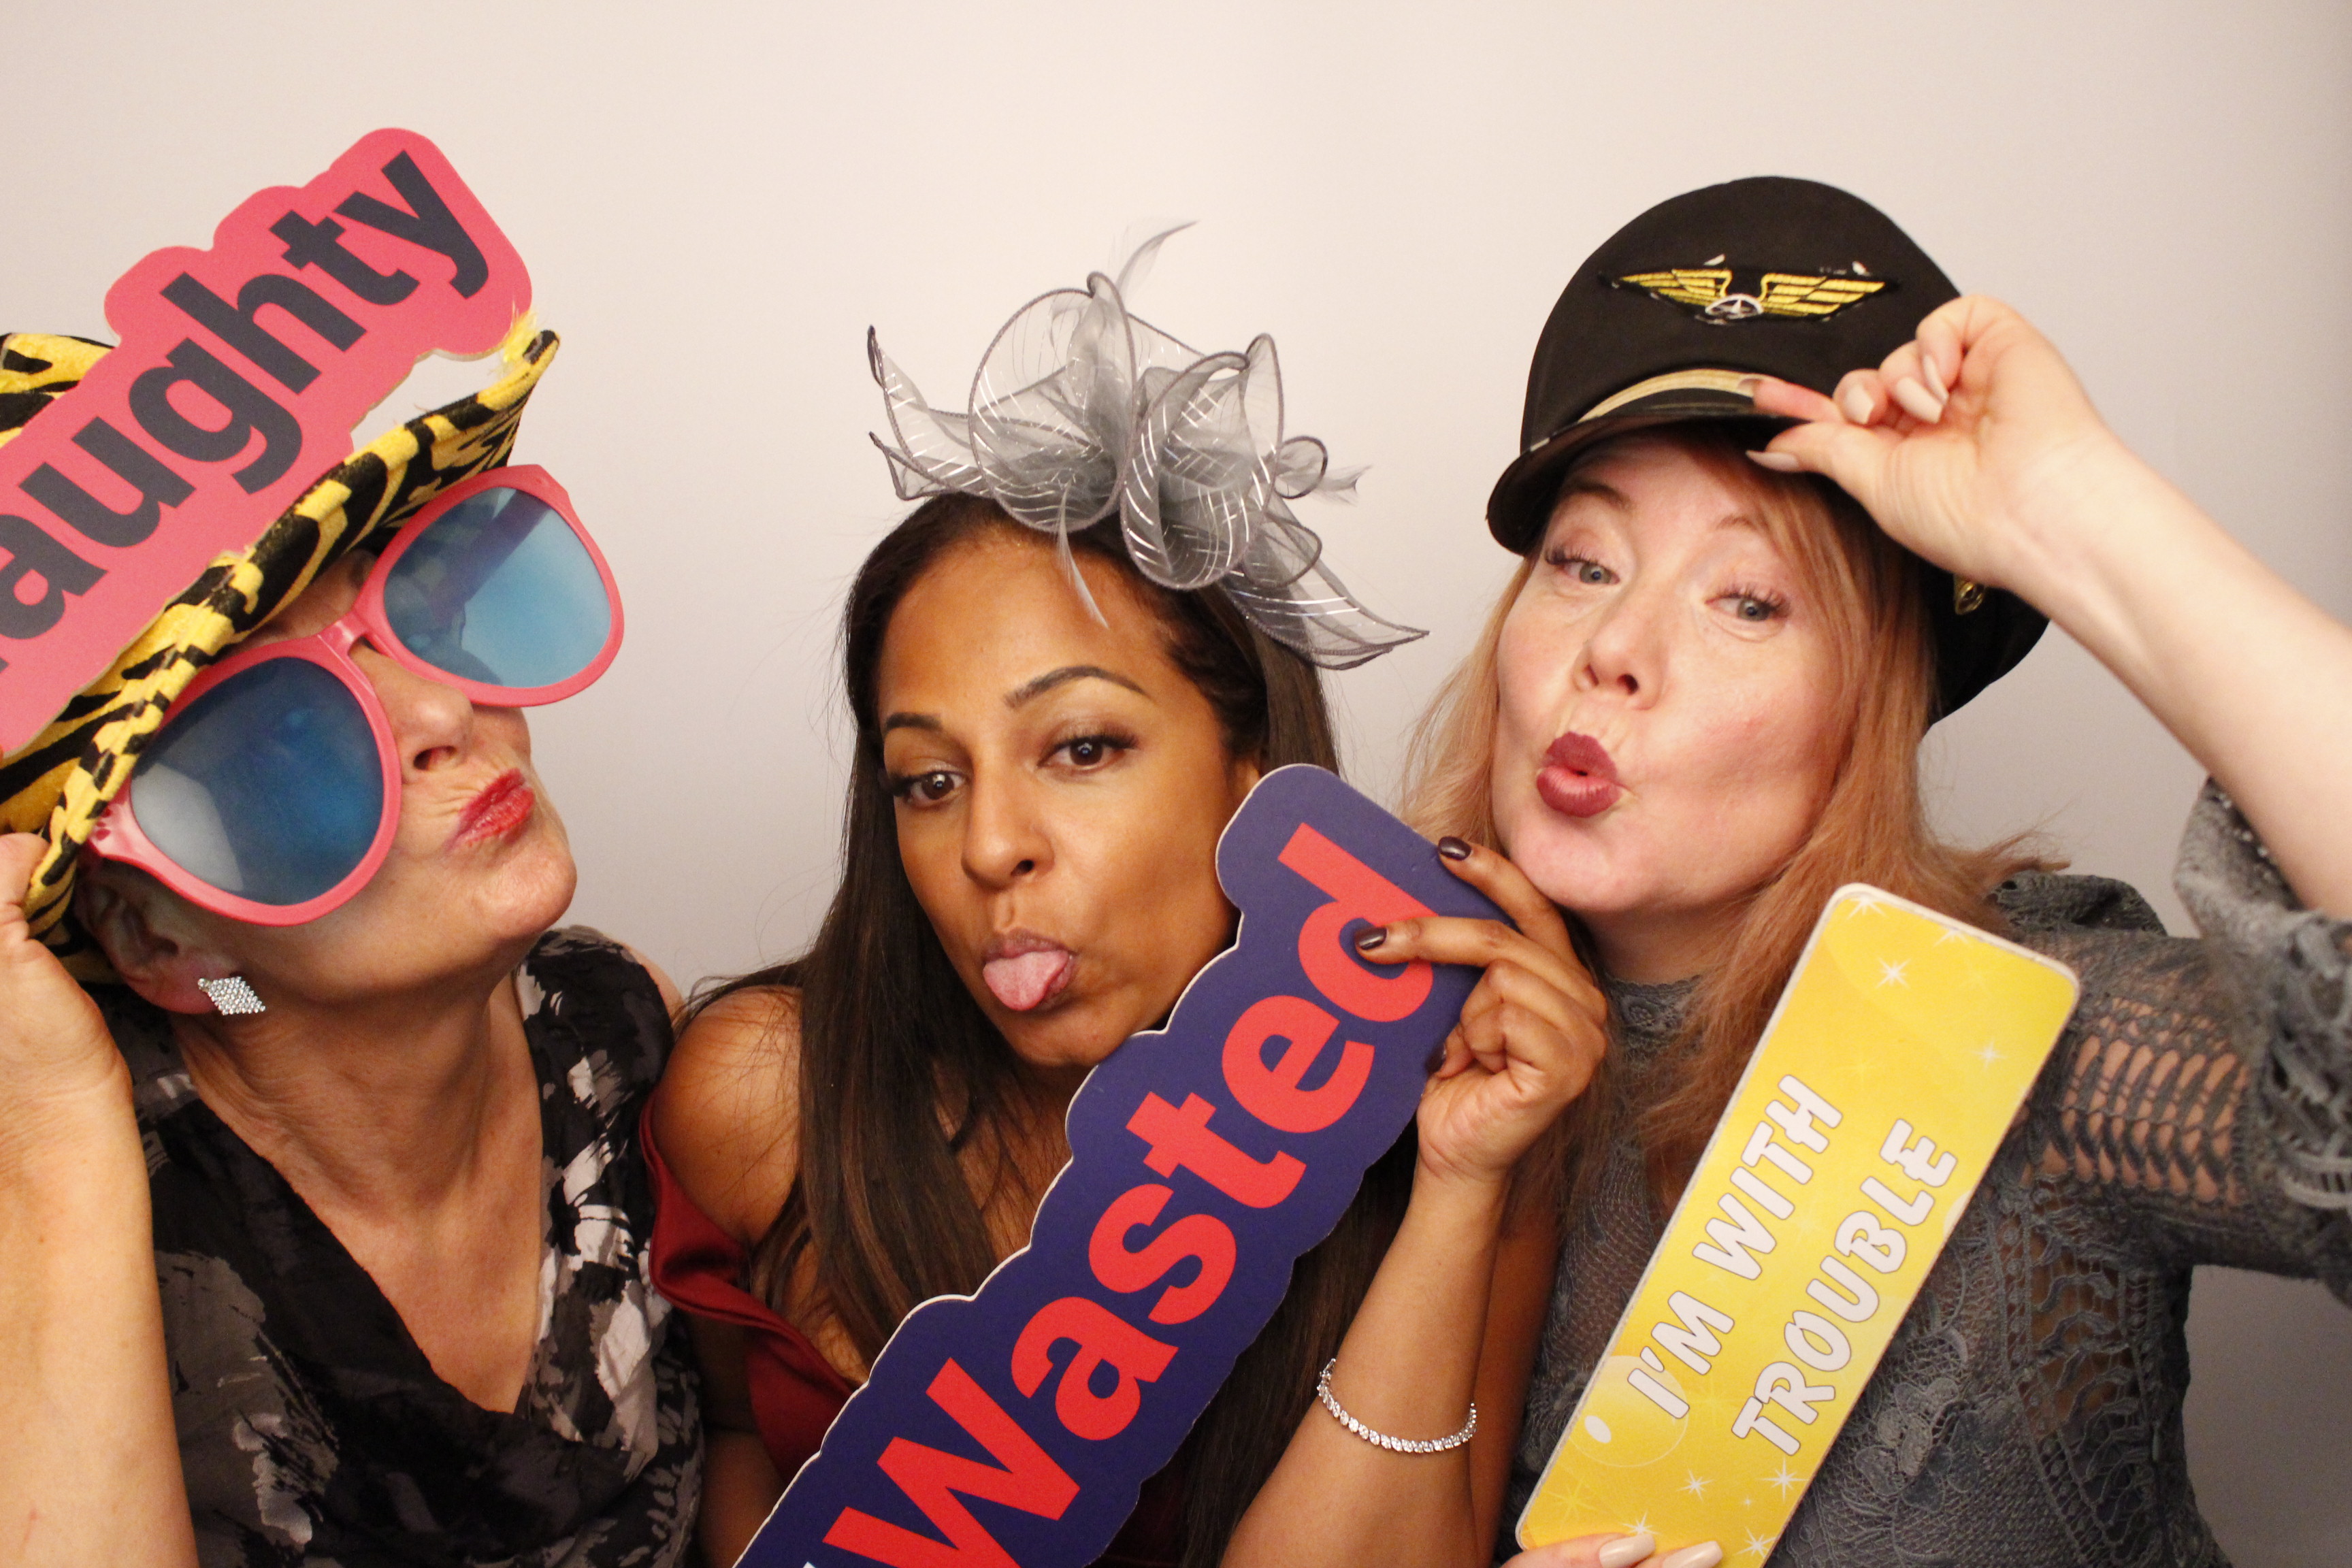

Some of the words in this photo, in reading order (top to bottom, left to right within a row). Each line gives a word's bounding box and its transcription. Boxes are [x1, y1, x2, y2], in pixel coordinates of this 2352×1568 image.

[0, 151, 489, 673] aughty
[822, 822, 1440, 1568] Wasted
[1627, 1290, 1735, 1420] I'M
[1692, 1075, 1843, 1281] WITH
[1731, 1118, 1959, 1456] TROUBLE
